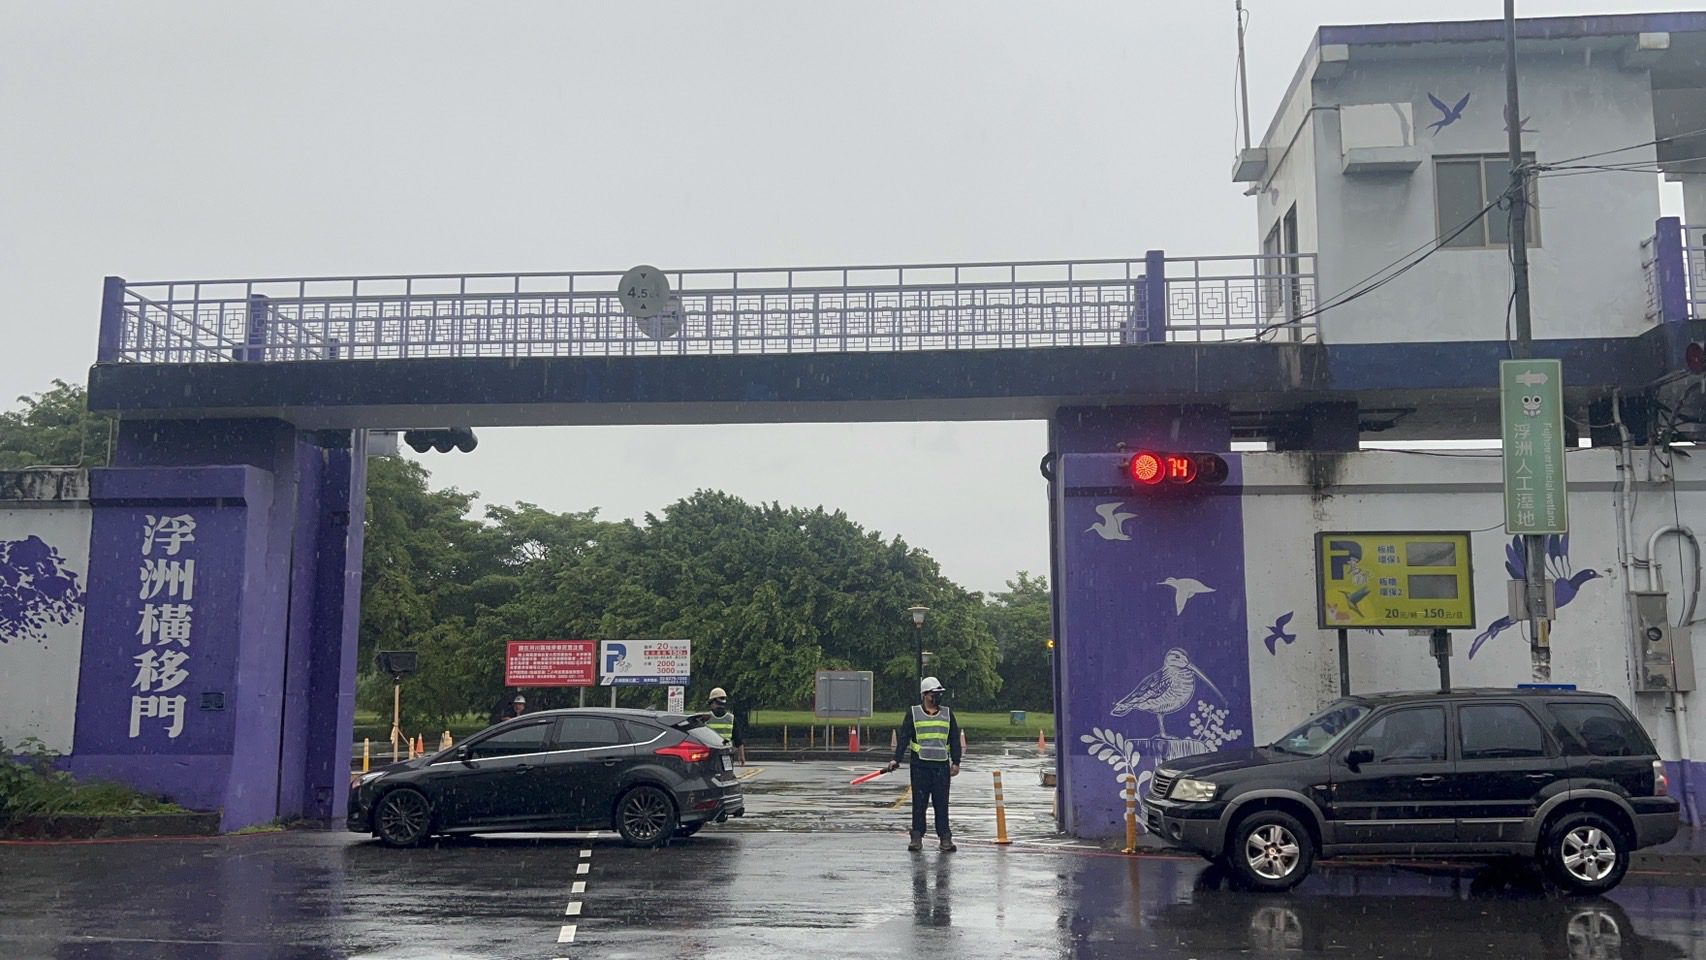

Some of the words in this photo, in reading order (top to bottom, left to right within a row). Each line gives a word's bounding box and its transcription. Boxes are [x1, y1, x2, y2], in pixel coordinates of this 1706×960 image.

[627, 286, 648, 298] 4.5
[1168, 458, 1188, 477] 74
[1544, 455, 1555, 491] artificial
[1546, 493, 1557, 527] wetland
[128, 513, 197, 738] 浮洲橫移門
